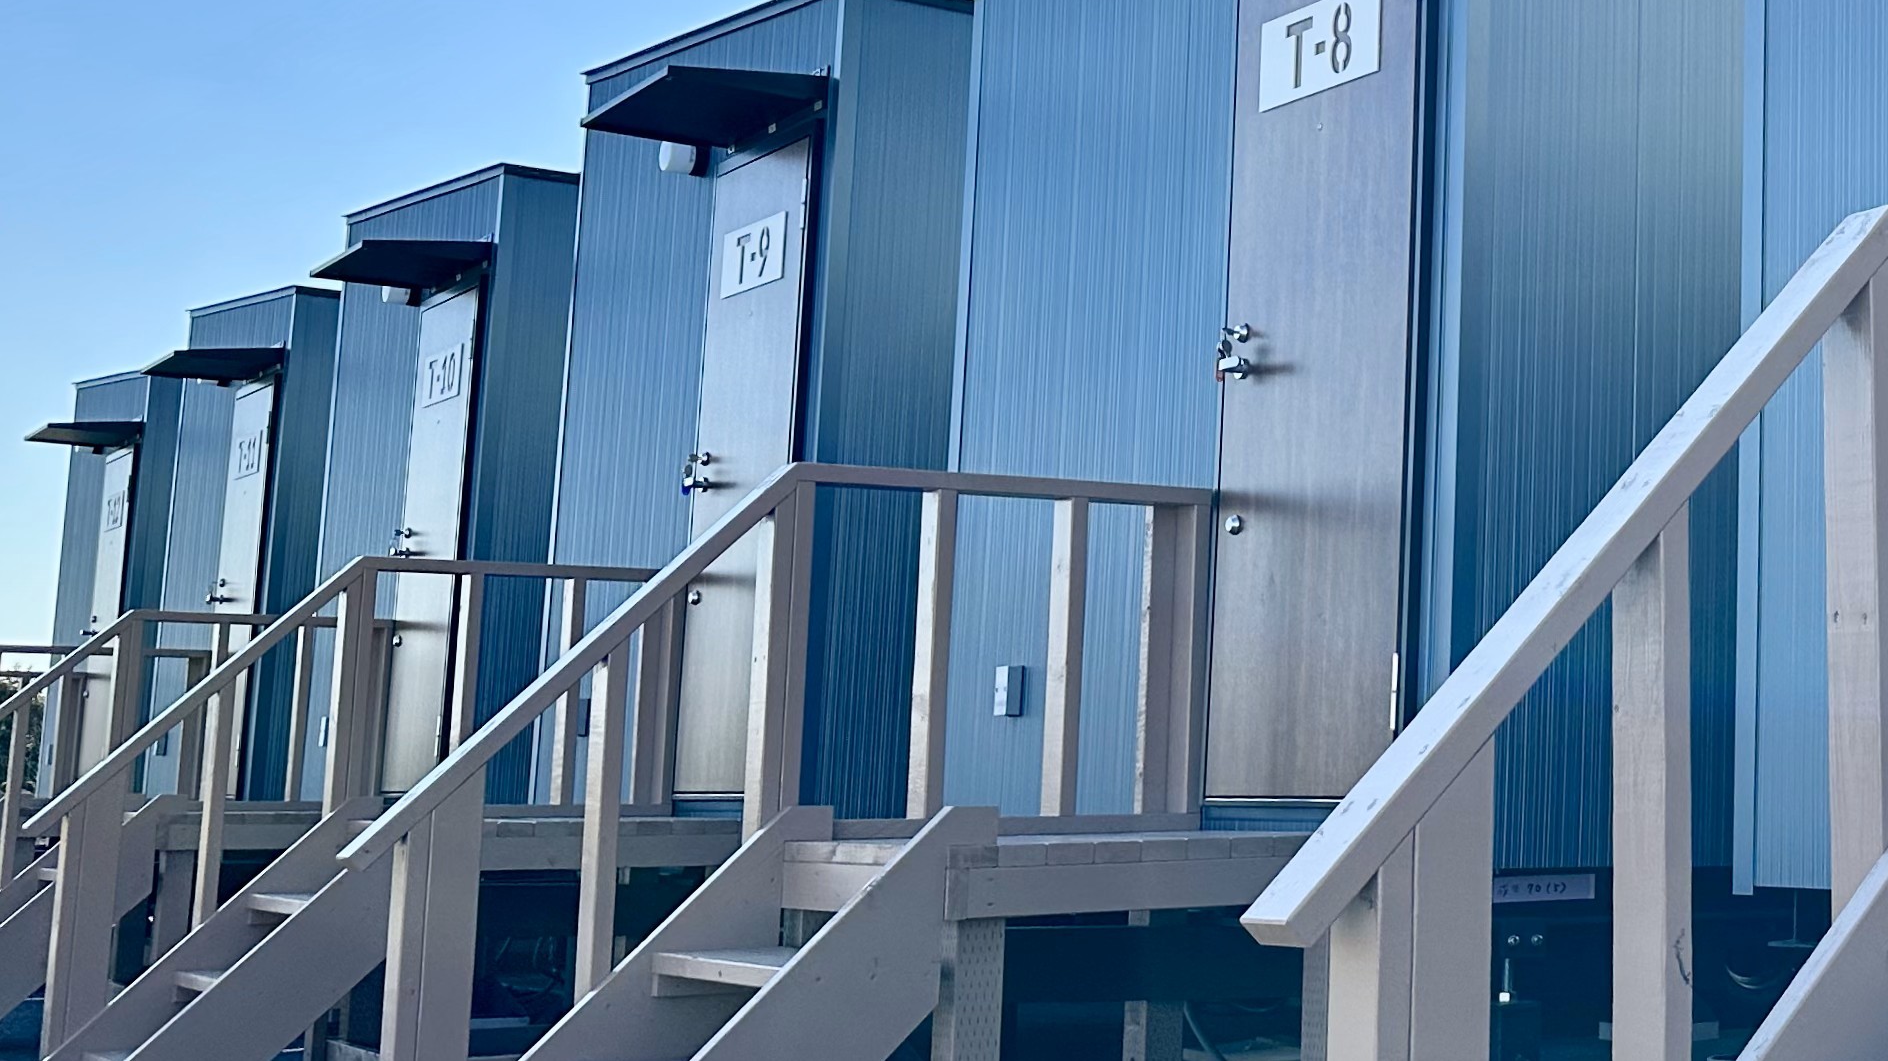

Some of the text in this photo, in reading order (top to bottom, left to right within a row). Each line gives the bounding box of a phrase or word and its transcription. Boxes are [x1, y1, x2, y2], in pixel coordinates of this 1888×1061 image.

[1286, 2, 1352, 89] T-8
[736, 225, 770, 285] T-9
[428, 351, 455, 399] T-10
[239, 436, 256, 473] T-11
